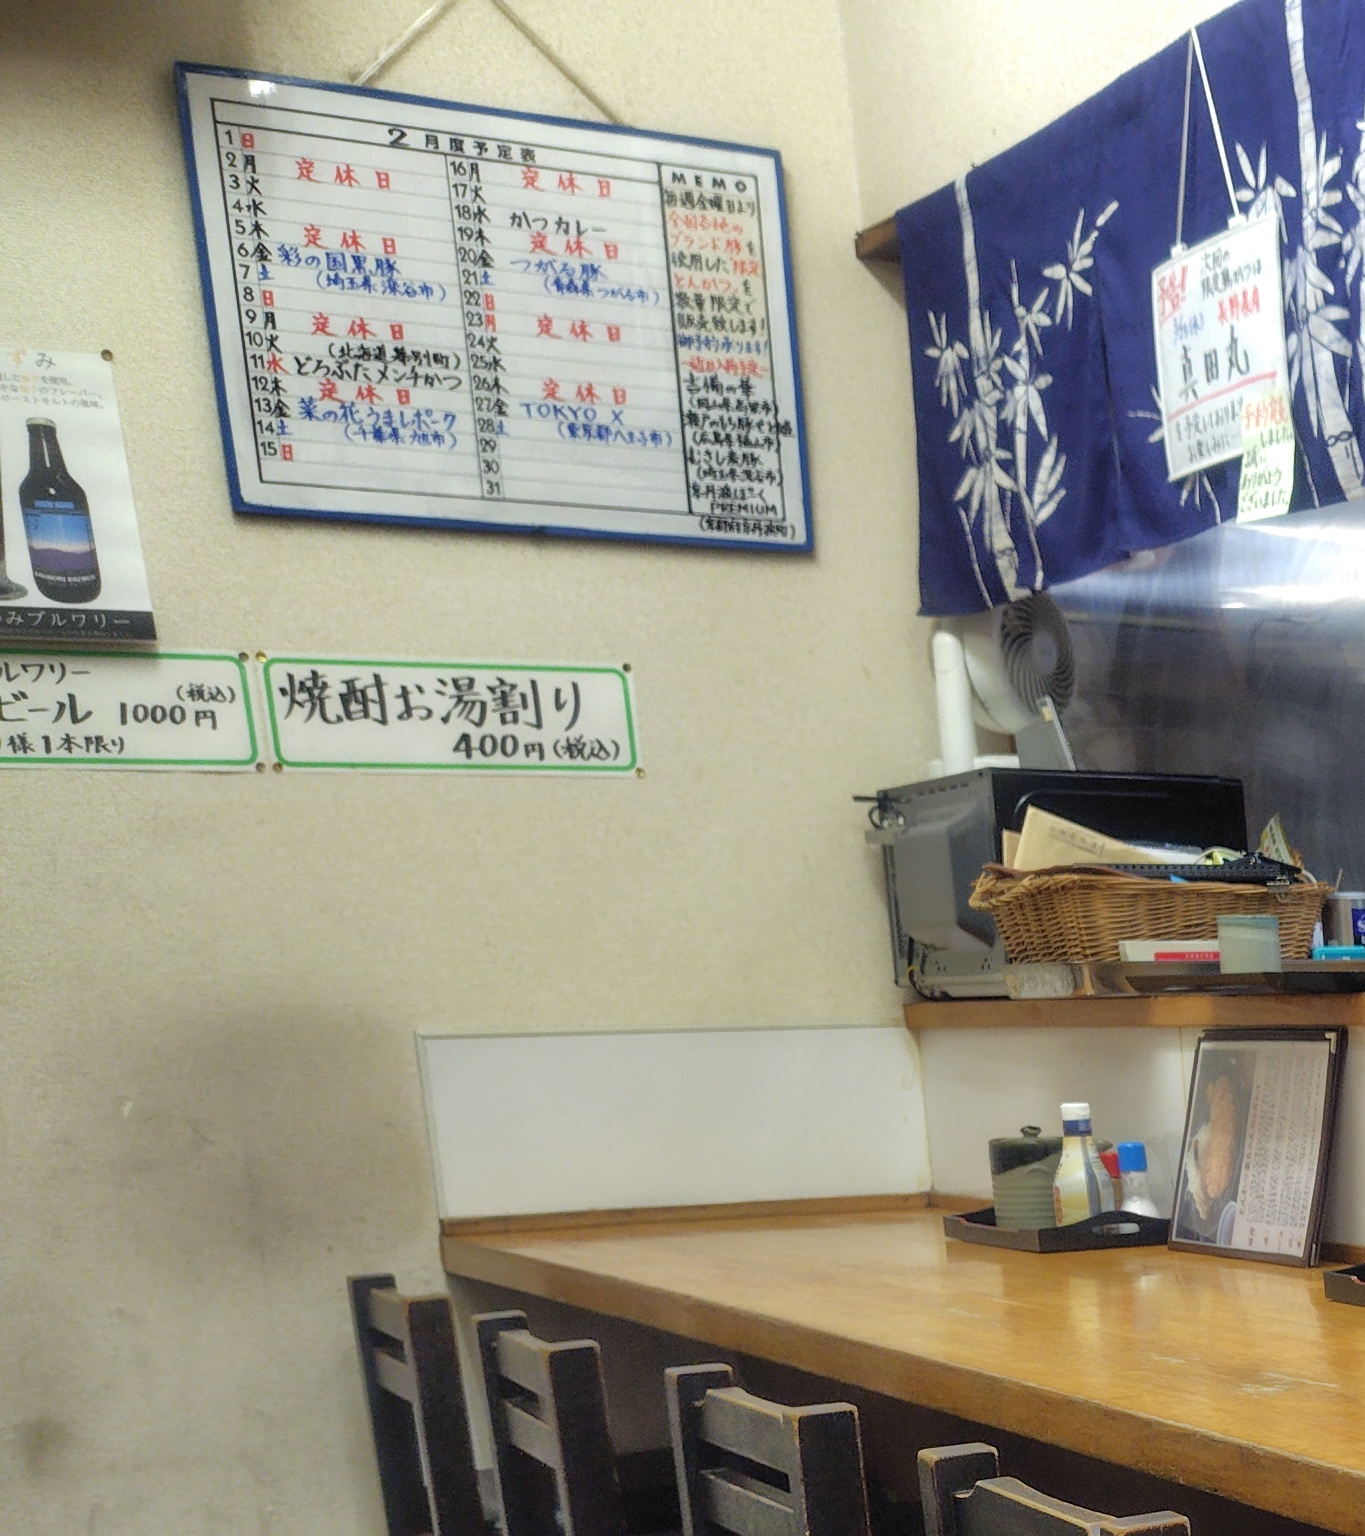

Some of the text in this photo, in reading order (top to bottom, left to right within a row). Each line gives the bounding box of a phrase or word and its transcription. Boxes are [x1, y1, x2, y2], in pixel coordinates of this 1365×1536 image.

[225, 129, 254, 149] 1 日
[226, 152, 256, 174] 2 月
[450, 161, 480, 183] 16 月
[295, 157, 392, 191] 定休日
[522, 166, 612, 198] 定休日
[671, 172, 747, 193] MEMO
[229, 174, 262, 196] 3 火
[453, 183, 486, 204] 17 火
[232, 198, 267, 217] 4 水
[456, 205, 491, 224] 18 水
[235, 220, 269, 240] 5 木
[510, 211, 607, 236] かつカレー
[303, 224, 398, 255] 定休日
[458, 227, 491, 247] 19 木
[529, 231, 619, 260] 定休日
[238, 242, 272, 263] 6 金
[458, 247, 495, 268] 20 金
[240, 262, 275, 280] 7 土
[462, 270, 495, 286] 21 土
[243, 287, 275, 307] 8 日
[464, 290, 495, 311] 22 日
[245, 308, 277, 330] 9 月
[312, 311, 405, 341] 定休日
[466, 312, 483, 327] 23
[536, 313, 621, 343] 定休日
[246, 332, 283, 353] 10 火
[468, 333, 501, 354] 24 火
[250, 354, 289, 375] 11 水
[471, 355, 487, 369] 25
[252, 376, 288, 395] 12 木
[319, 377, 411, 405] 定休日
[474, 375, 489, 391] 26
[542, 377, 627, 406] 定休日
[255, 397, 291, 418] 13 金
[476, 397, 509, 417] 27 金
[519, 403, 625, 425] TOKYO X
[257, 419, 293, 436] 14 土
[478, 417, 495, 433] 28
[261, 440, 294, 461] 15 日
[481, 438, 496, 454] 29
[483, 459, 500, 474] 30
[487, 480, 501, 496] 31
[710, 502, 778, 516] PREMIUM
[277, 669, 584, 730] 焼酎お湯割り
